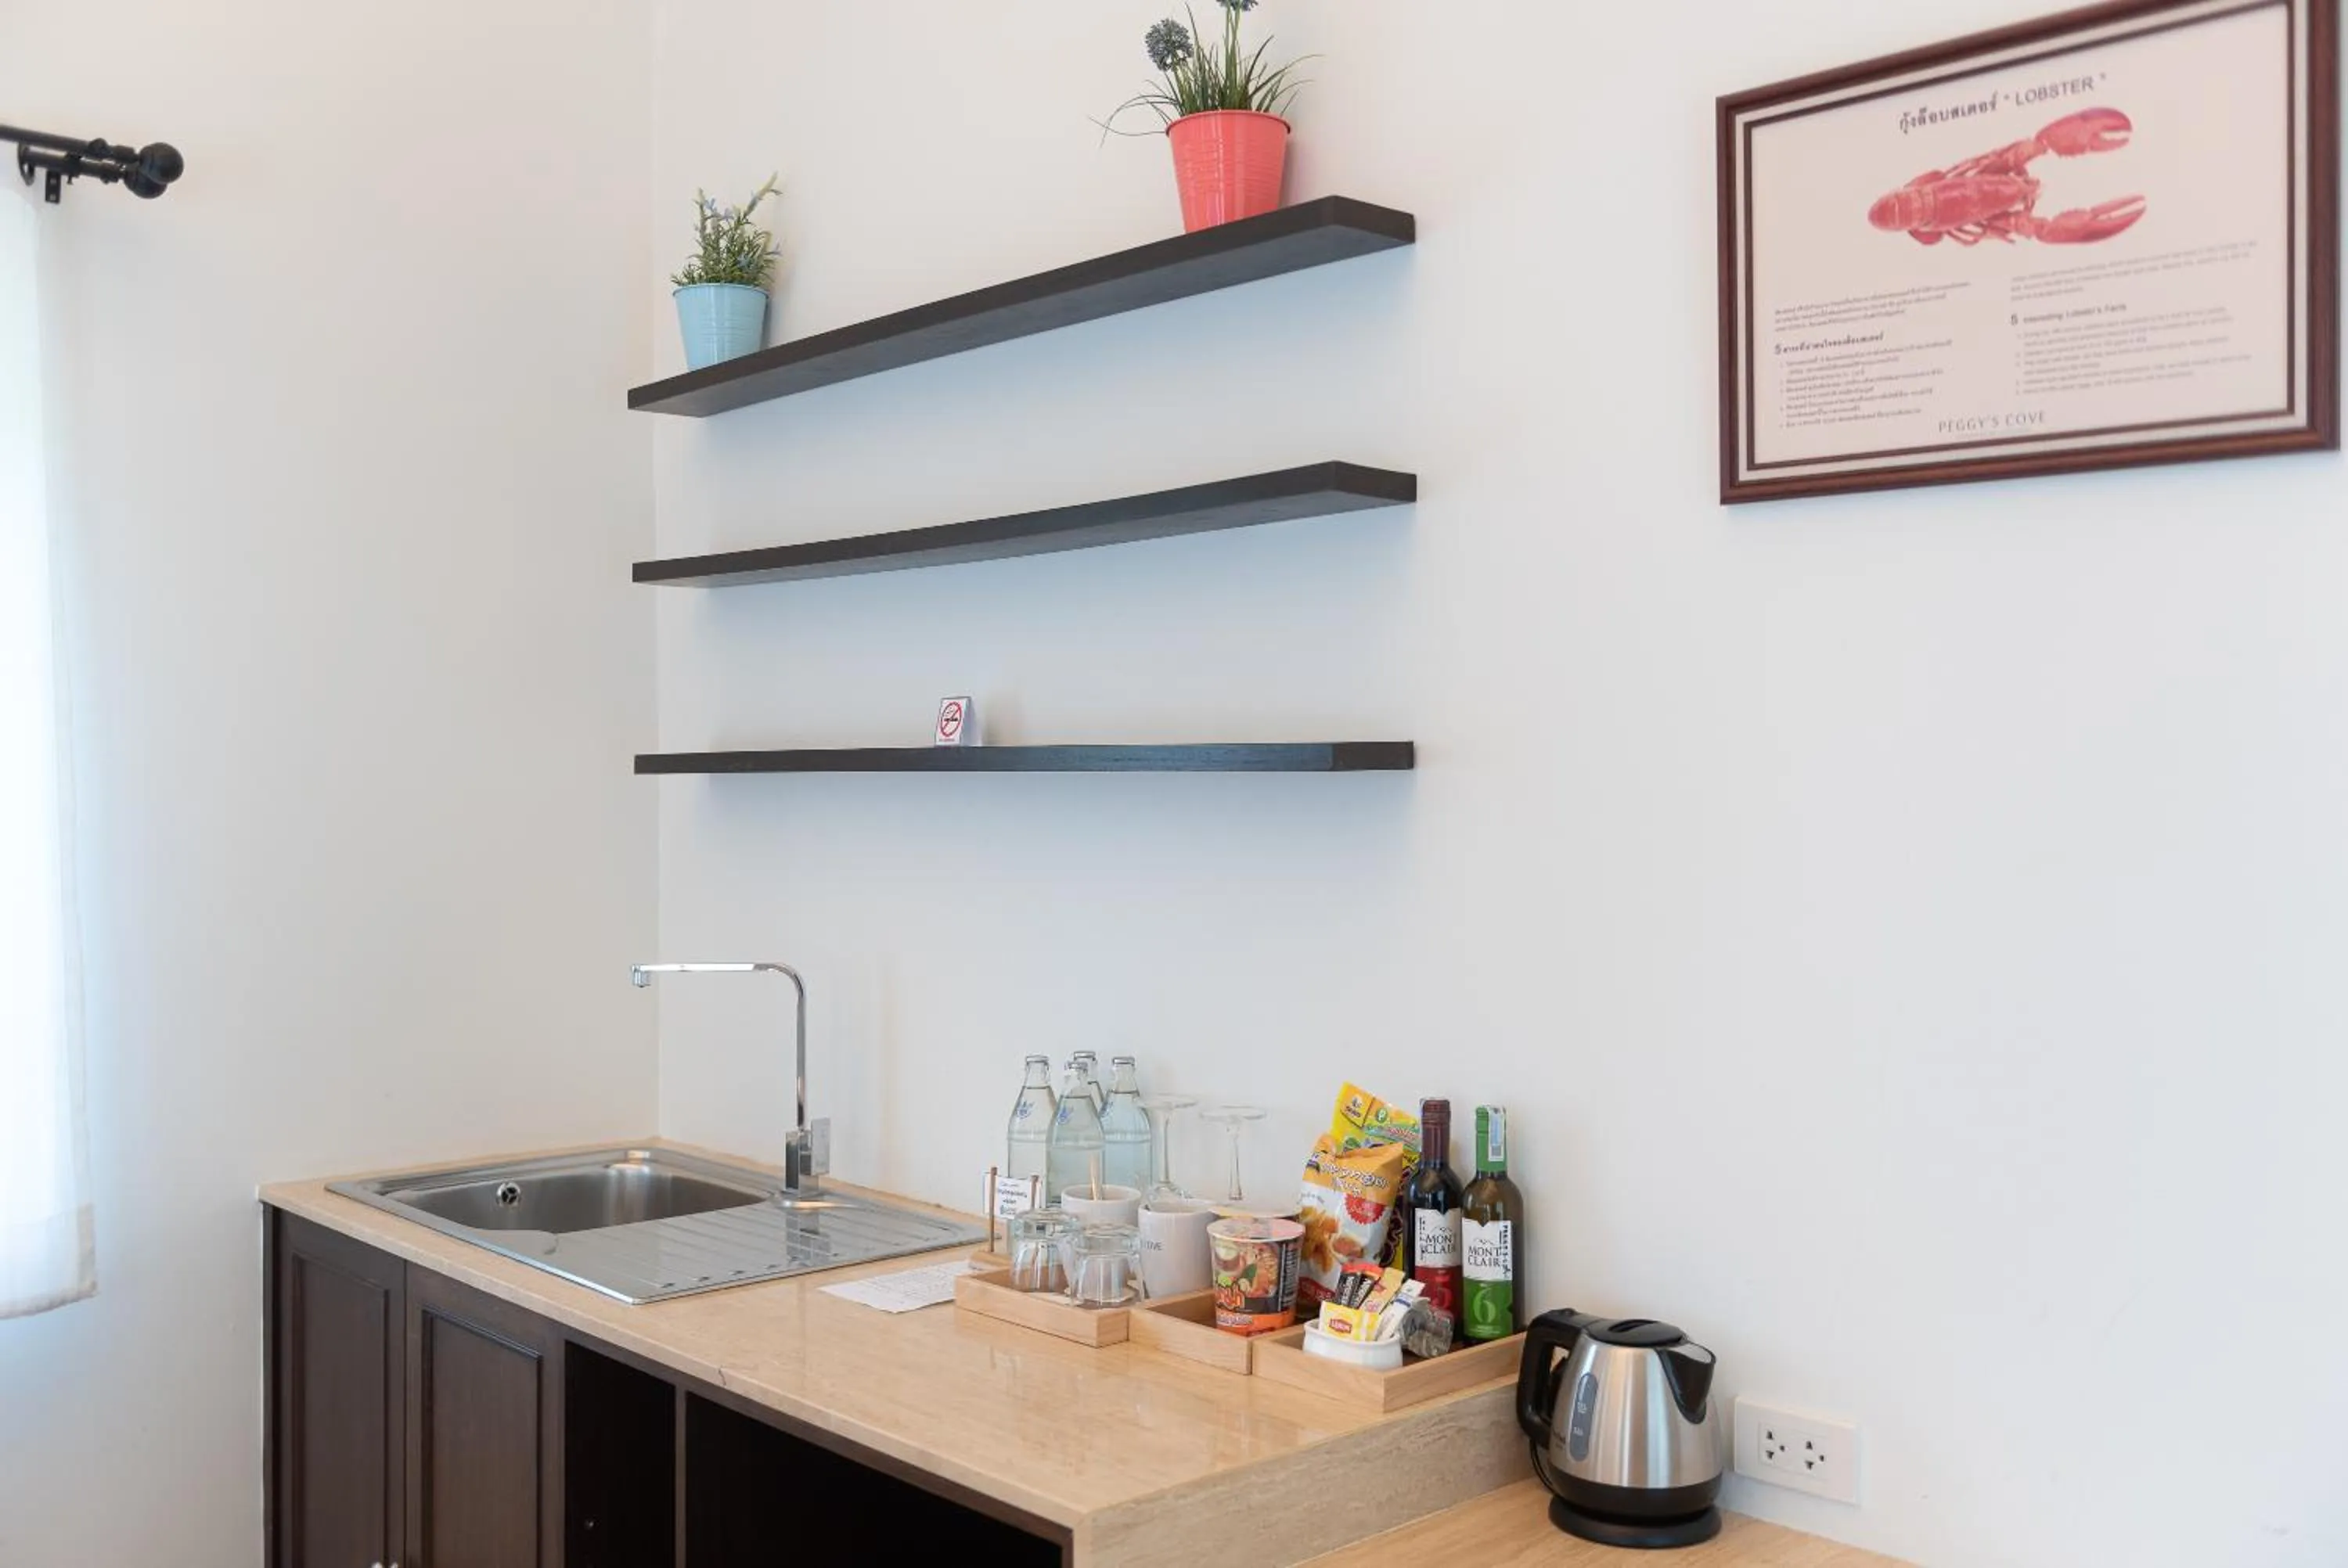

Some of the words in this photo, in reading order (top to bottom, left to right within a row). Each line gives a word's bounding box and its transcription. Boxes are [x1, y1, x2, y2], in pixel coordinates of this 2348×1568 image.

[2015, 76, 2095, 106] LOBSTER
[1938, 416, 1999, 433] PEGGY'S
[2004, 411, 2045, 427] COVE
[1468, 1246, 1502, 1257] MONT
[1468, 1255, 1501, 1267] CLAIR
[1474, 1288, 1496, 1324] 6
